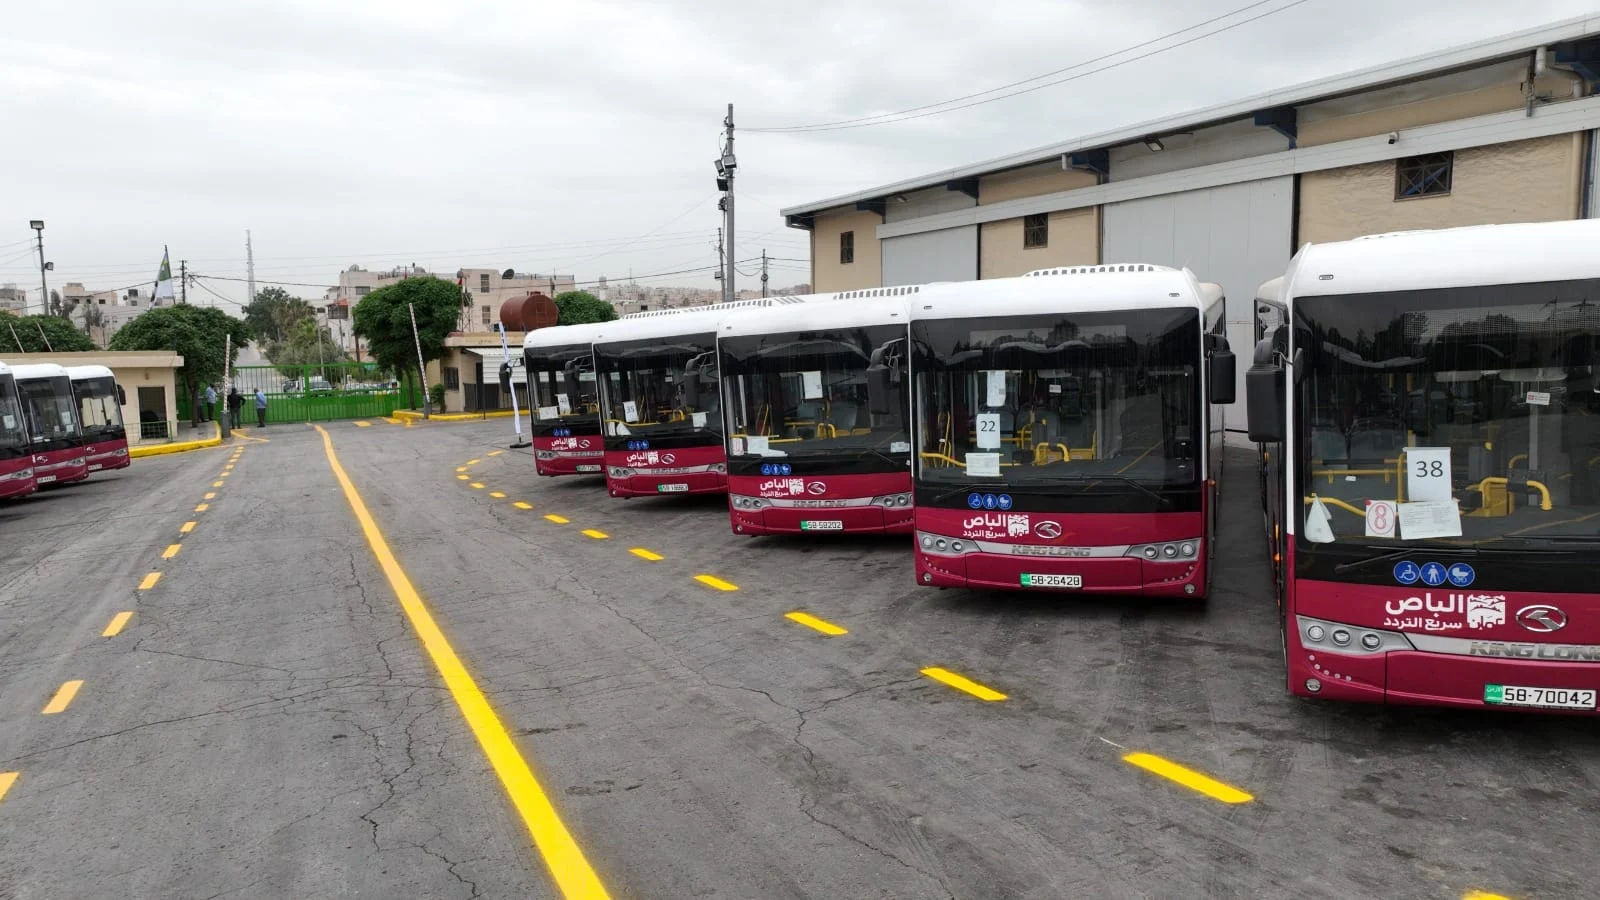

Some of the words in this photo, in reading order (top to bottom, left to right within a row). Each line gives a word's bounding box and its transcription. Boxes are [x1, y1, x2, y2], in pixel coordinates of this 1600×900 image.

[980, 420, 996, 432] 22
[1416, 460, 1444, 478] 38
[760, 478, 789, 491] الباص
[963, 513, 1006, 530] الباص
[963, 529, 985, 538] التردد
[985, 530, 1006, 538] سريع
[1385, 592, 1464, 618] الباص
[1383, 617, 1423, 629] التردد
[1424, 618, 1463, 631] سريع
[1504, 687, 1593, 705] 58-70042
